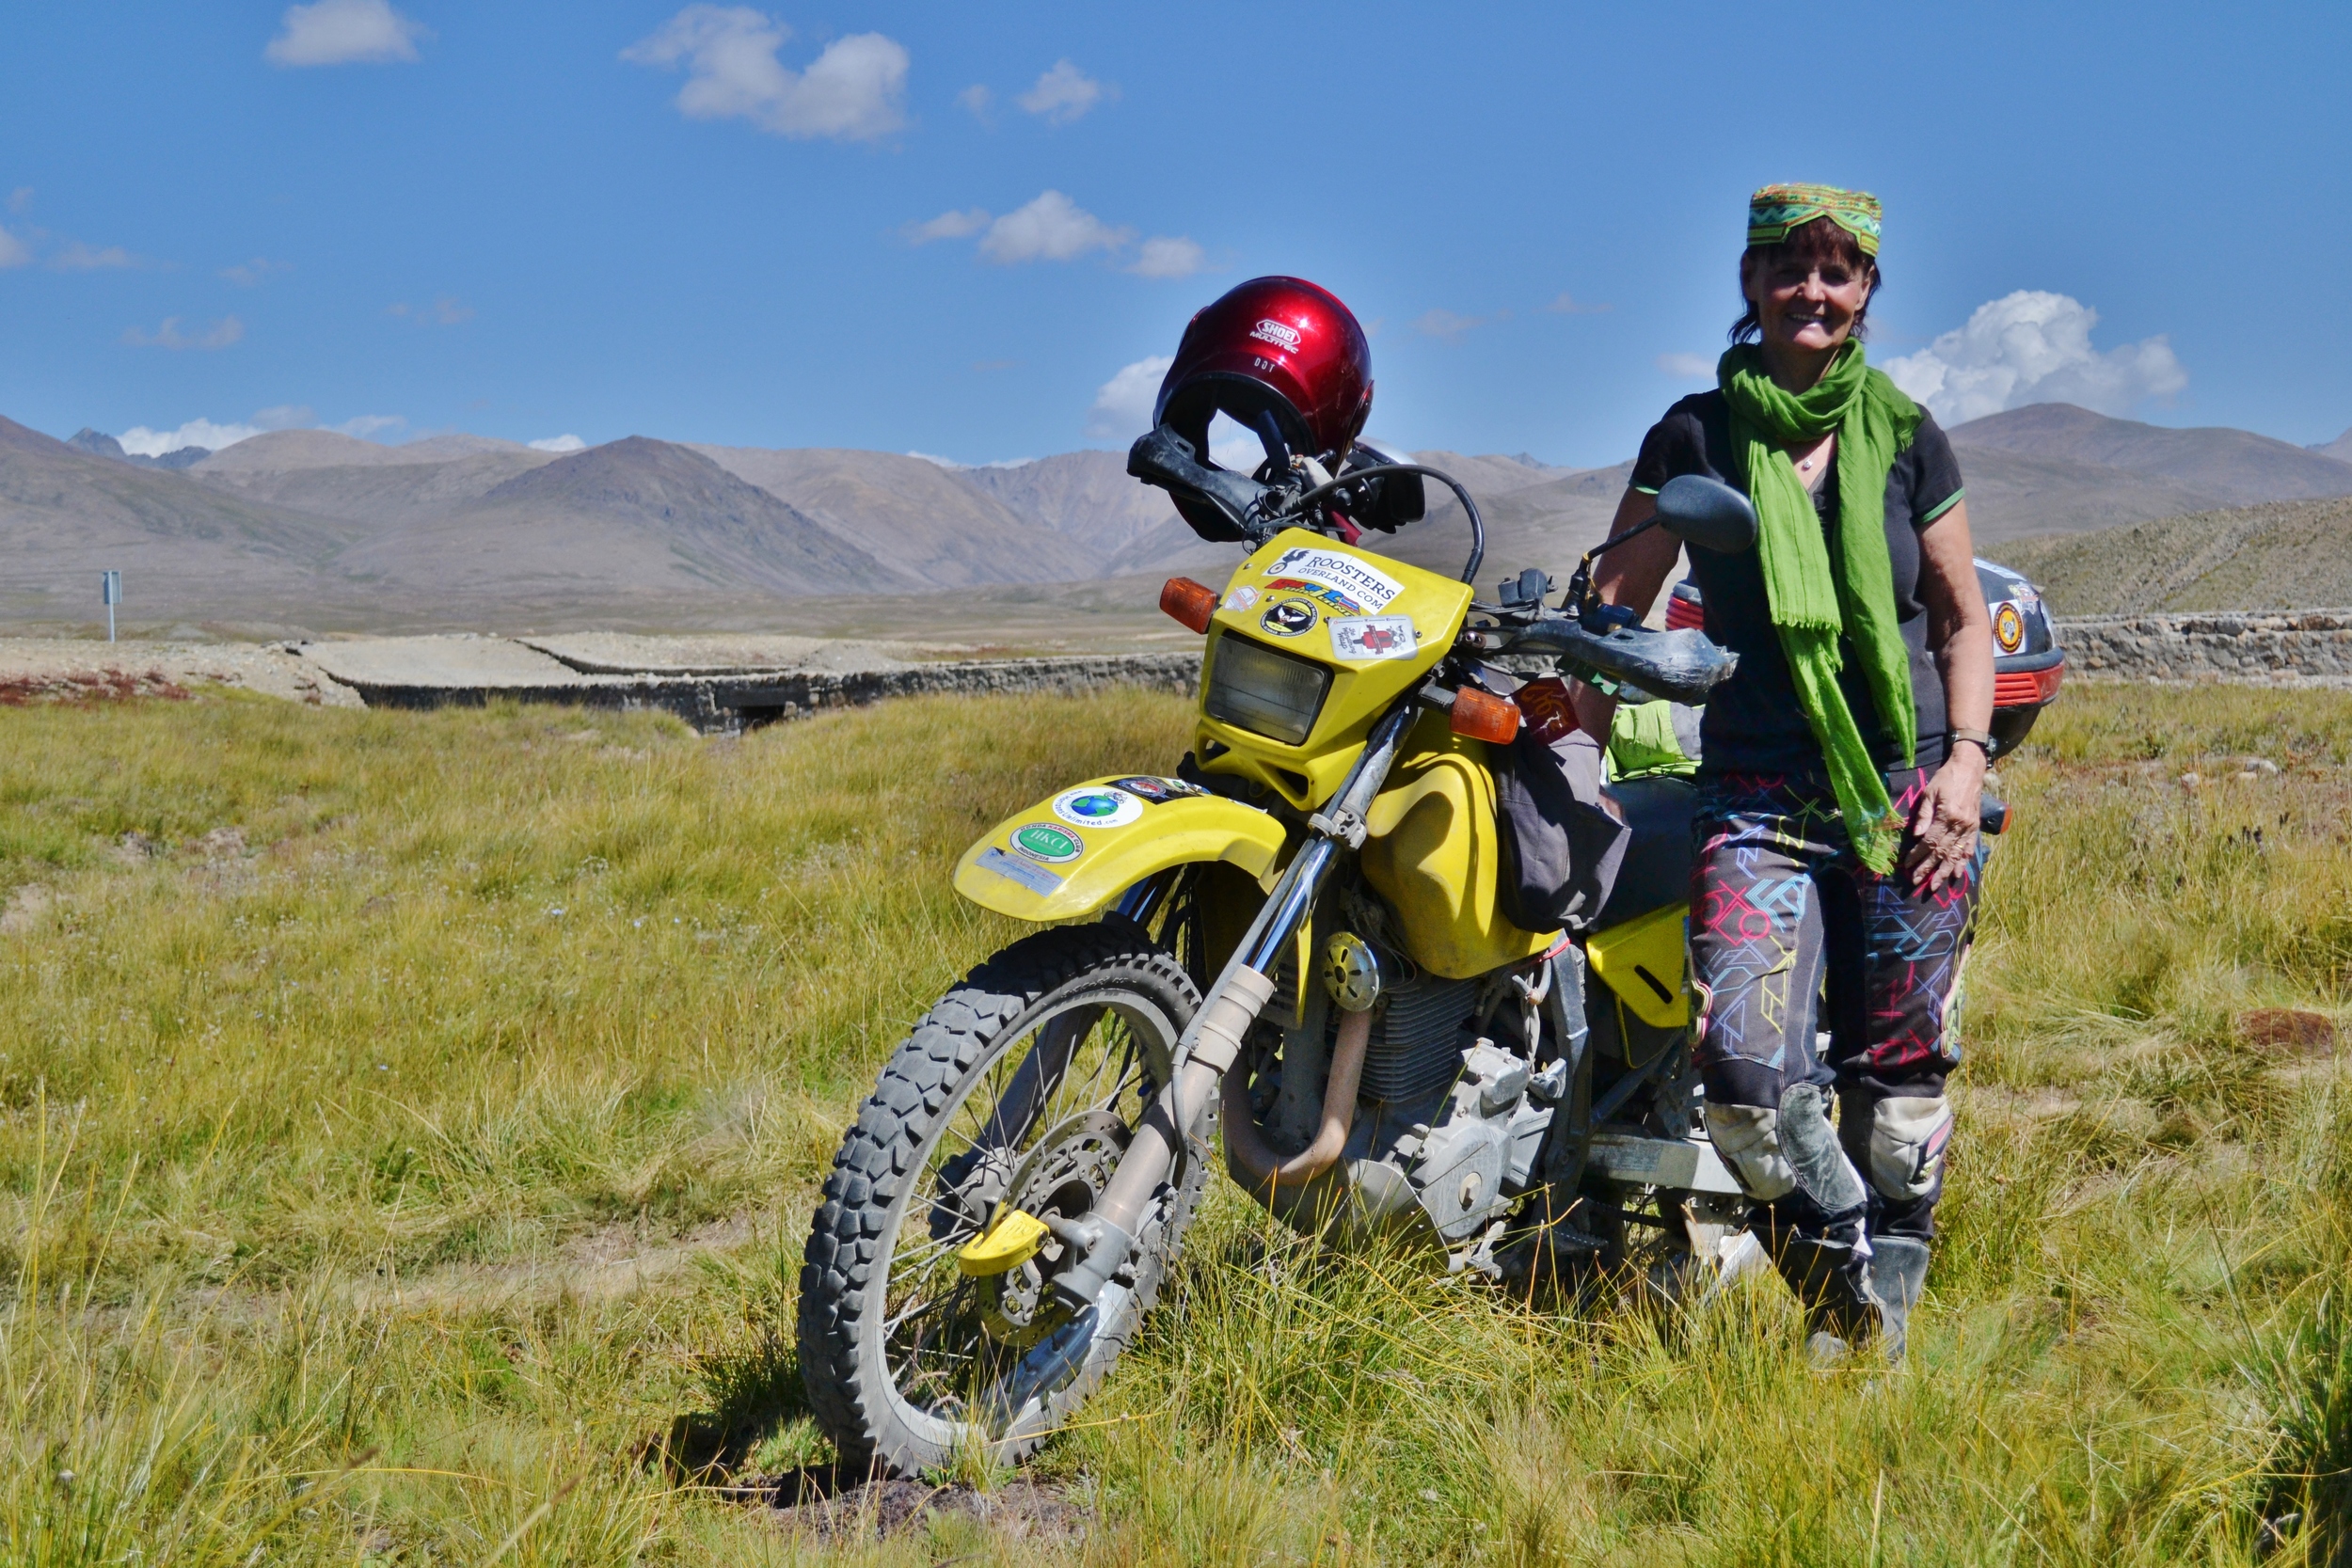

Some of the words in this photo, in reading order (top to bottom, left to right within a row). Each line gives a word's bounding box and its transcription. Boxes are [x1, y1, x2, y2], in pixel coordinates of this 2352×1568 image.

[1249, 330, 1299, 355] MULTITEC
[1262, 322, 1296, 343] SHOEI
[1305, 556, 1396, 600] ROOSTERS
[1018, 846, 1050, 862] INDONESIA
